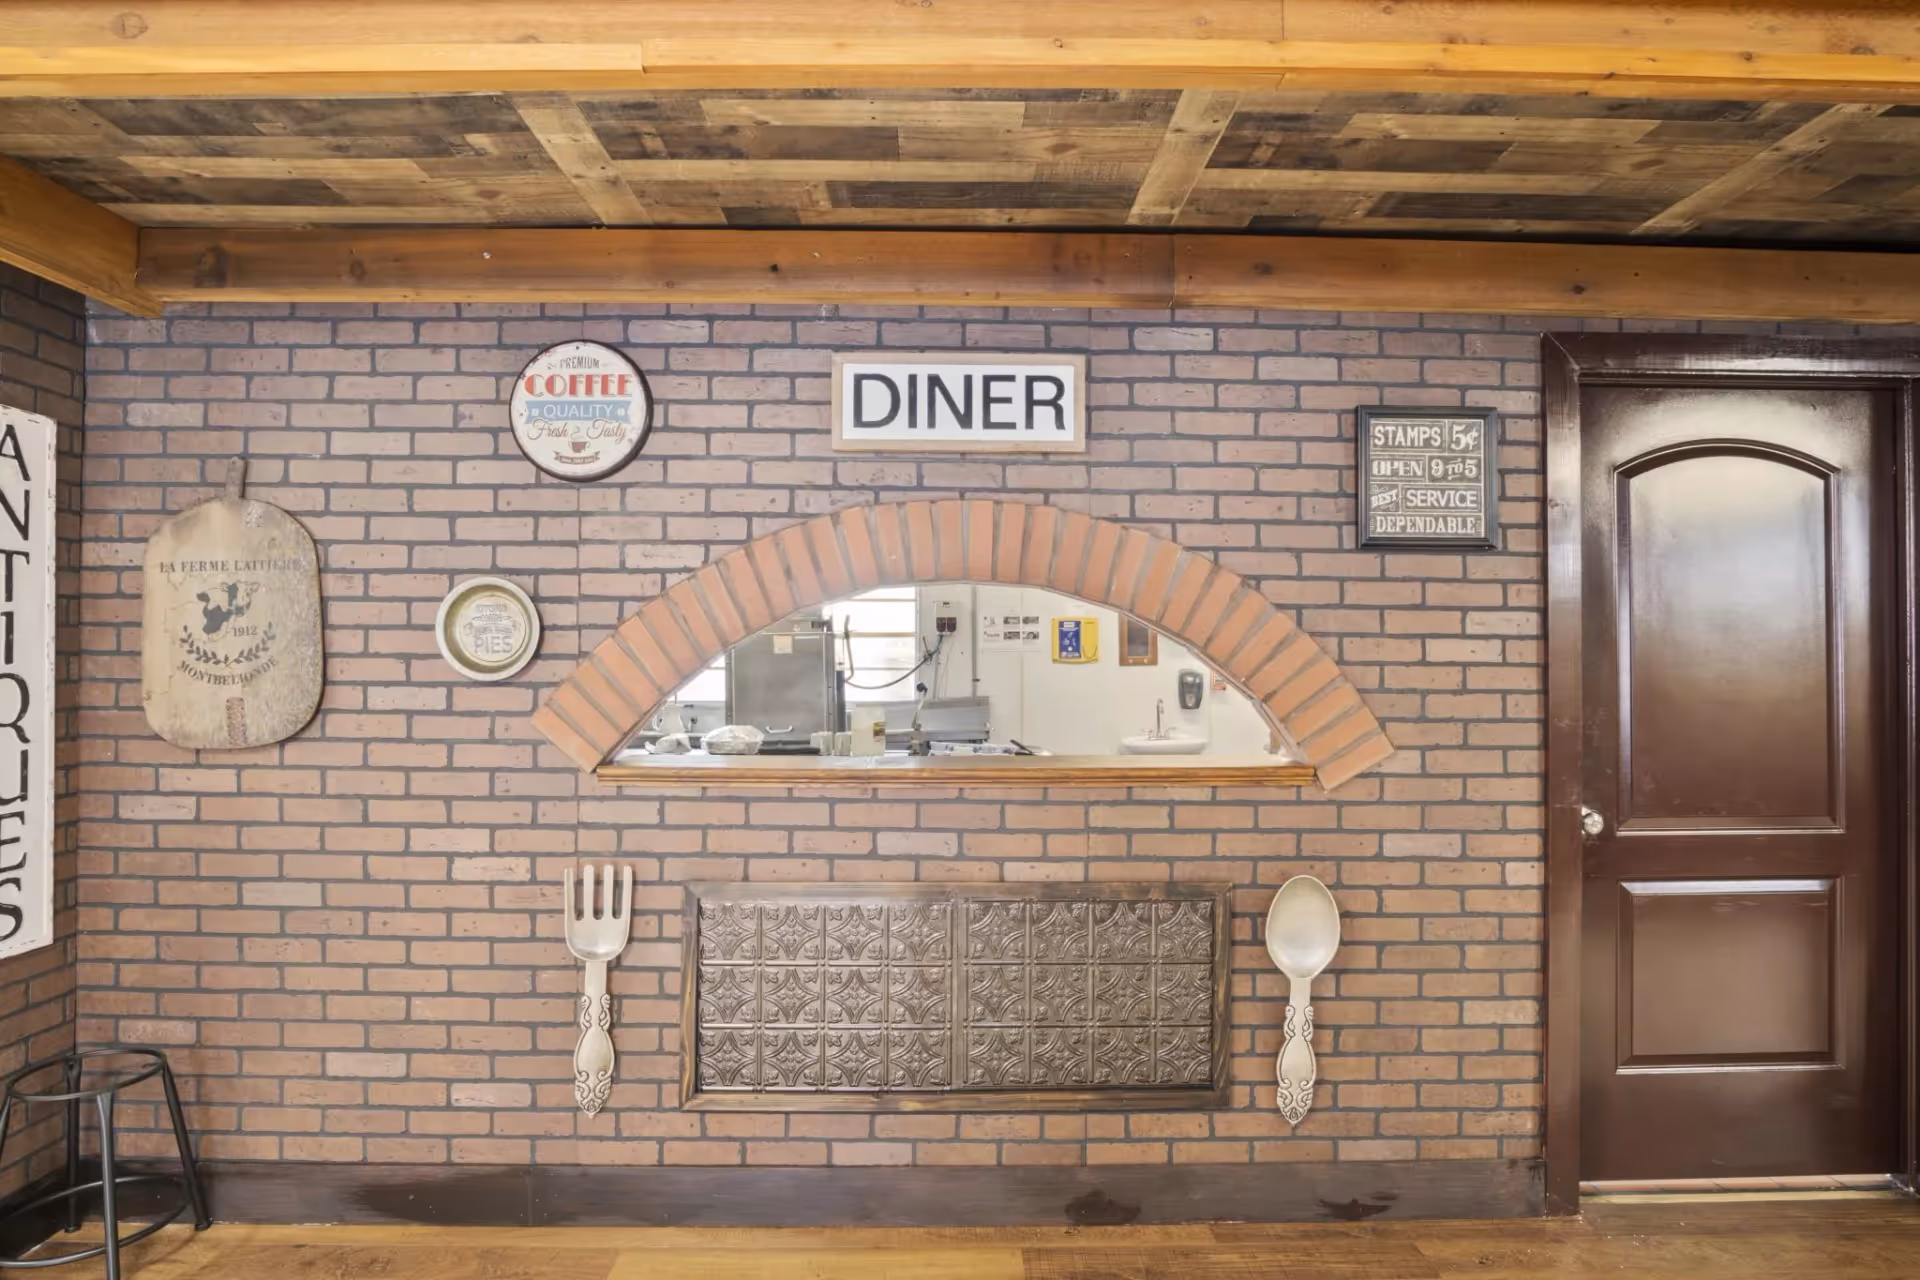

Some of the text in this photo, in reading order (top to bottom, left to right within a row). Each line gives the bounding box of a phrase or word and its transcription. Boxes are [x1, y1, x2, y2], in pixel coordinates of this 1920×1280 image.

[560, 356, 600, 369] PREMIUM
[524, 374, 633, 397] COFFEE
[543, 404, 614, 418] QUALITY
[853, 373, 1066, 431] DINER
[527, 418, 569, 441] Fresh
[586, 418, 628, 445] Tasty
[1374, 426, 1441, 447] STAMPS
[1372, 460, 1423, 476] OPEN
[1370, 488, 1477, 509] BEST SERVICE
[1375, 515, 1476, 534] DEPENDABLE
[160, 561, 176, 574] LA
[181, 559, 230, 573] FERME
[232, 625, 257, 637] 1912
[473, 634, 514, 655] PIES
